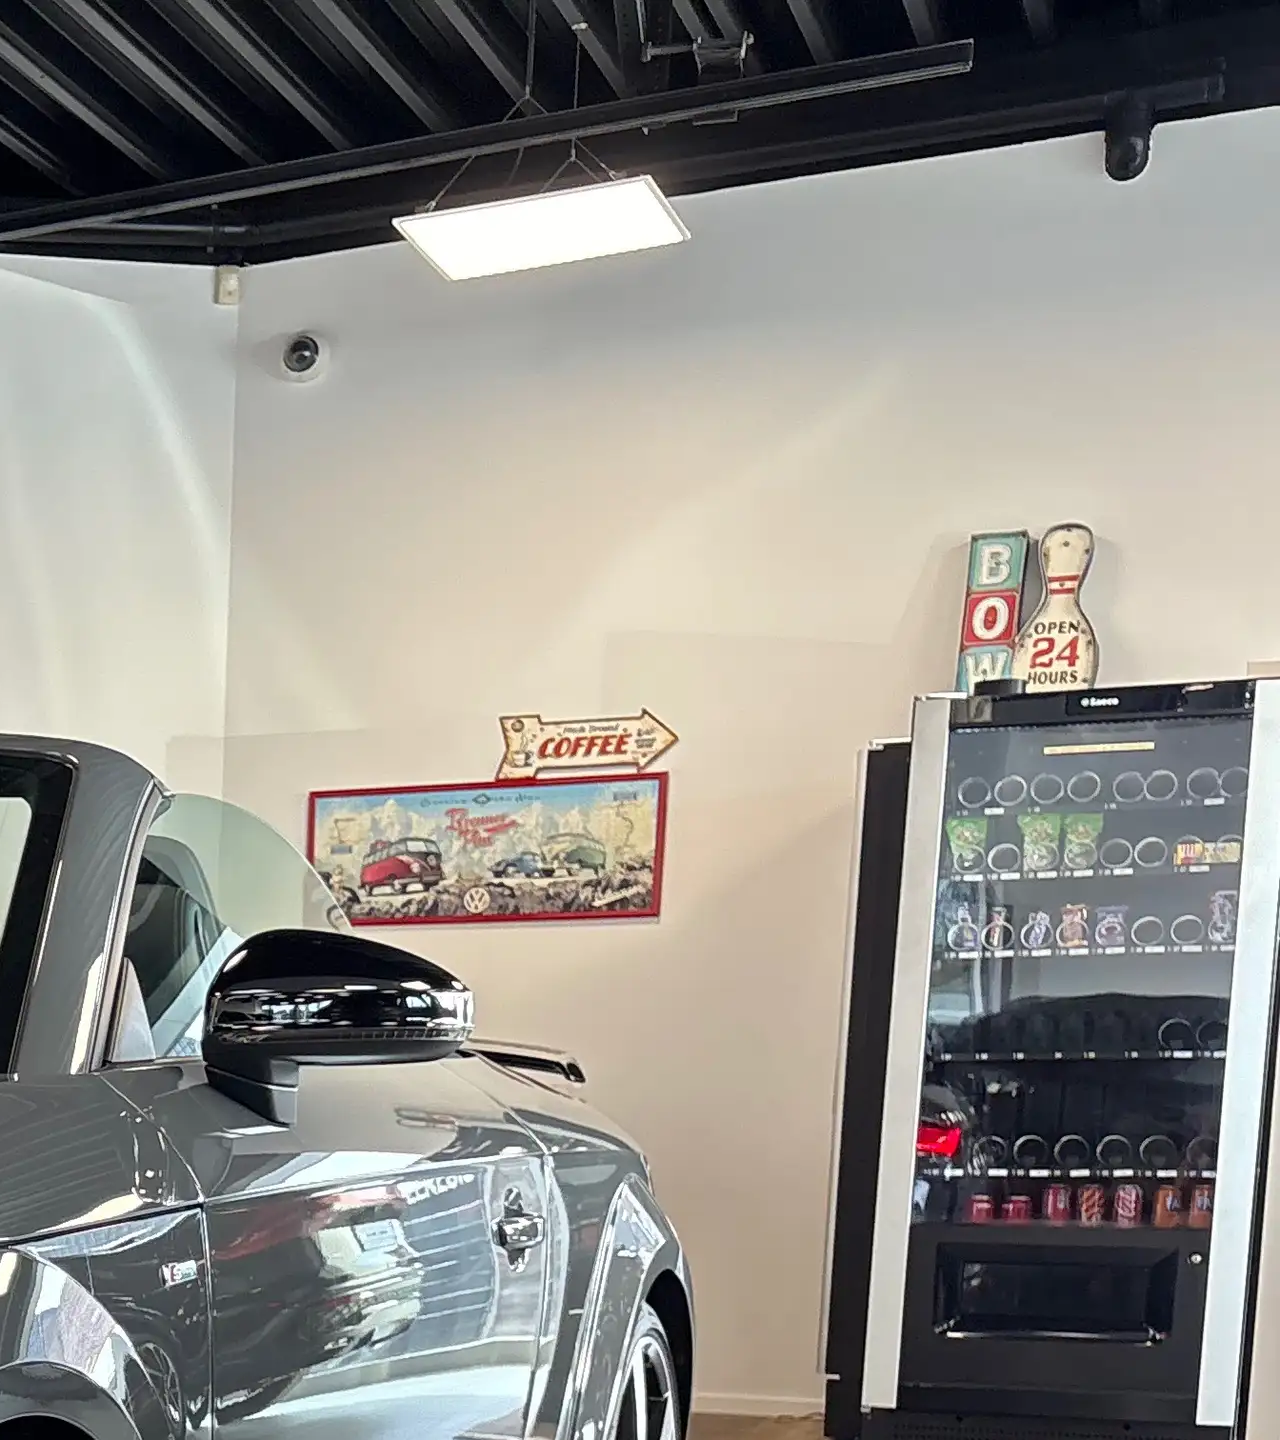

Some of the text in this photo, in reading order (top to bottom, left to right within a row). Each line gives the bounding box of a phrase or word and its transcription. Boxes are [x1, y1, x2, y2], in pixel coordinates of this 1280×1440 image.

[1034, 620, 1080, 635] OPEN
[1029, 635, 1080, 669] 24
[1026, 669, 1079, 685] HOURS
[537, 733, 632, 759] COFFEE
